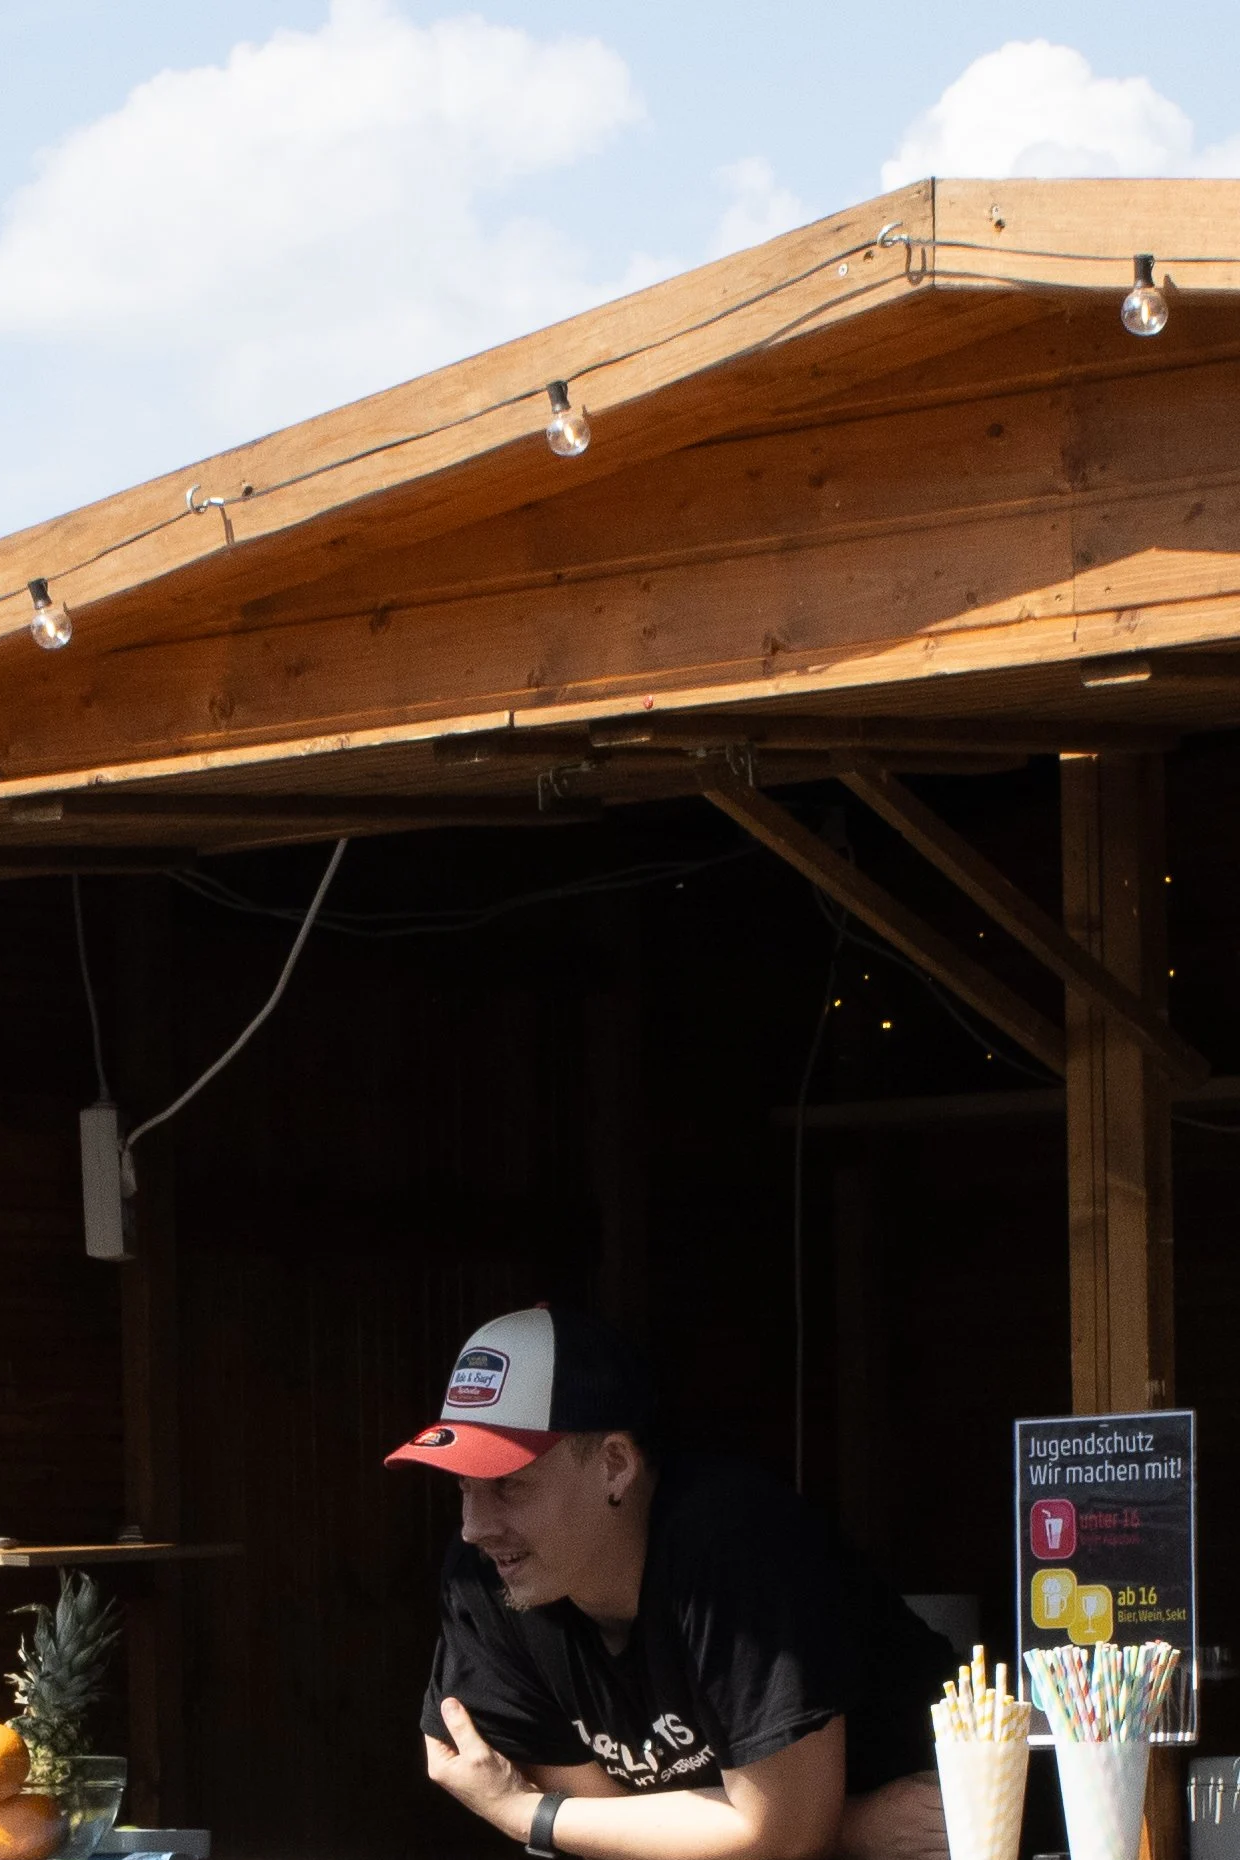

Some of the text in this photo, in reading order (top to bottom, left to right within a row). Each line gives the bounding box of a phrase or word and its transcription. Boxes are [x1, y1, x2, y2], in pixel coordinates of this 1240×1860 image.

[1028, 1431, 1155, 1461] Jugendschutz
[1028, 1457, 1182, 1485] Wir machen mit!
[1117, 1586, 1158, 1606] ab 16
[1166, 1607, 1187, 1621] Sekt
